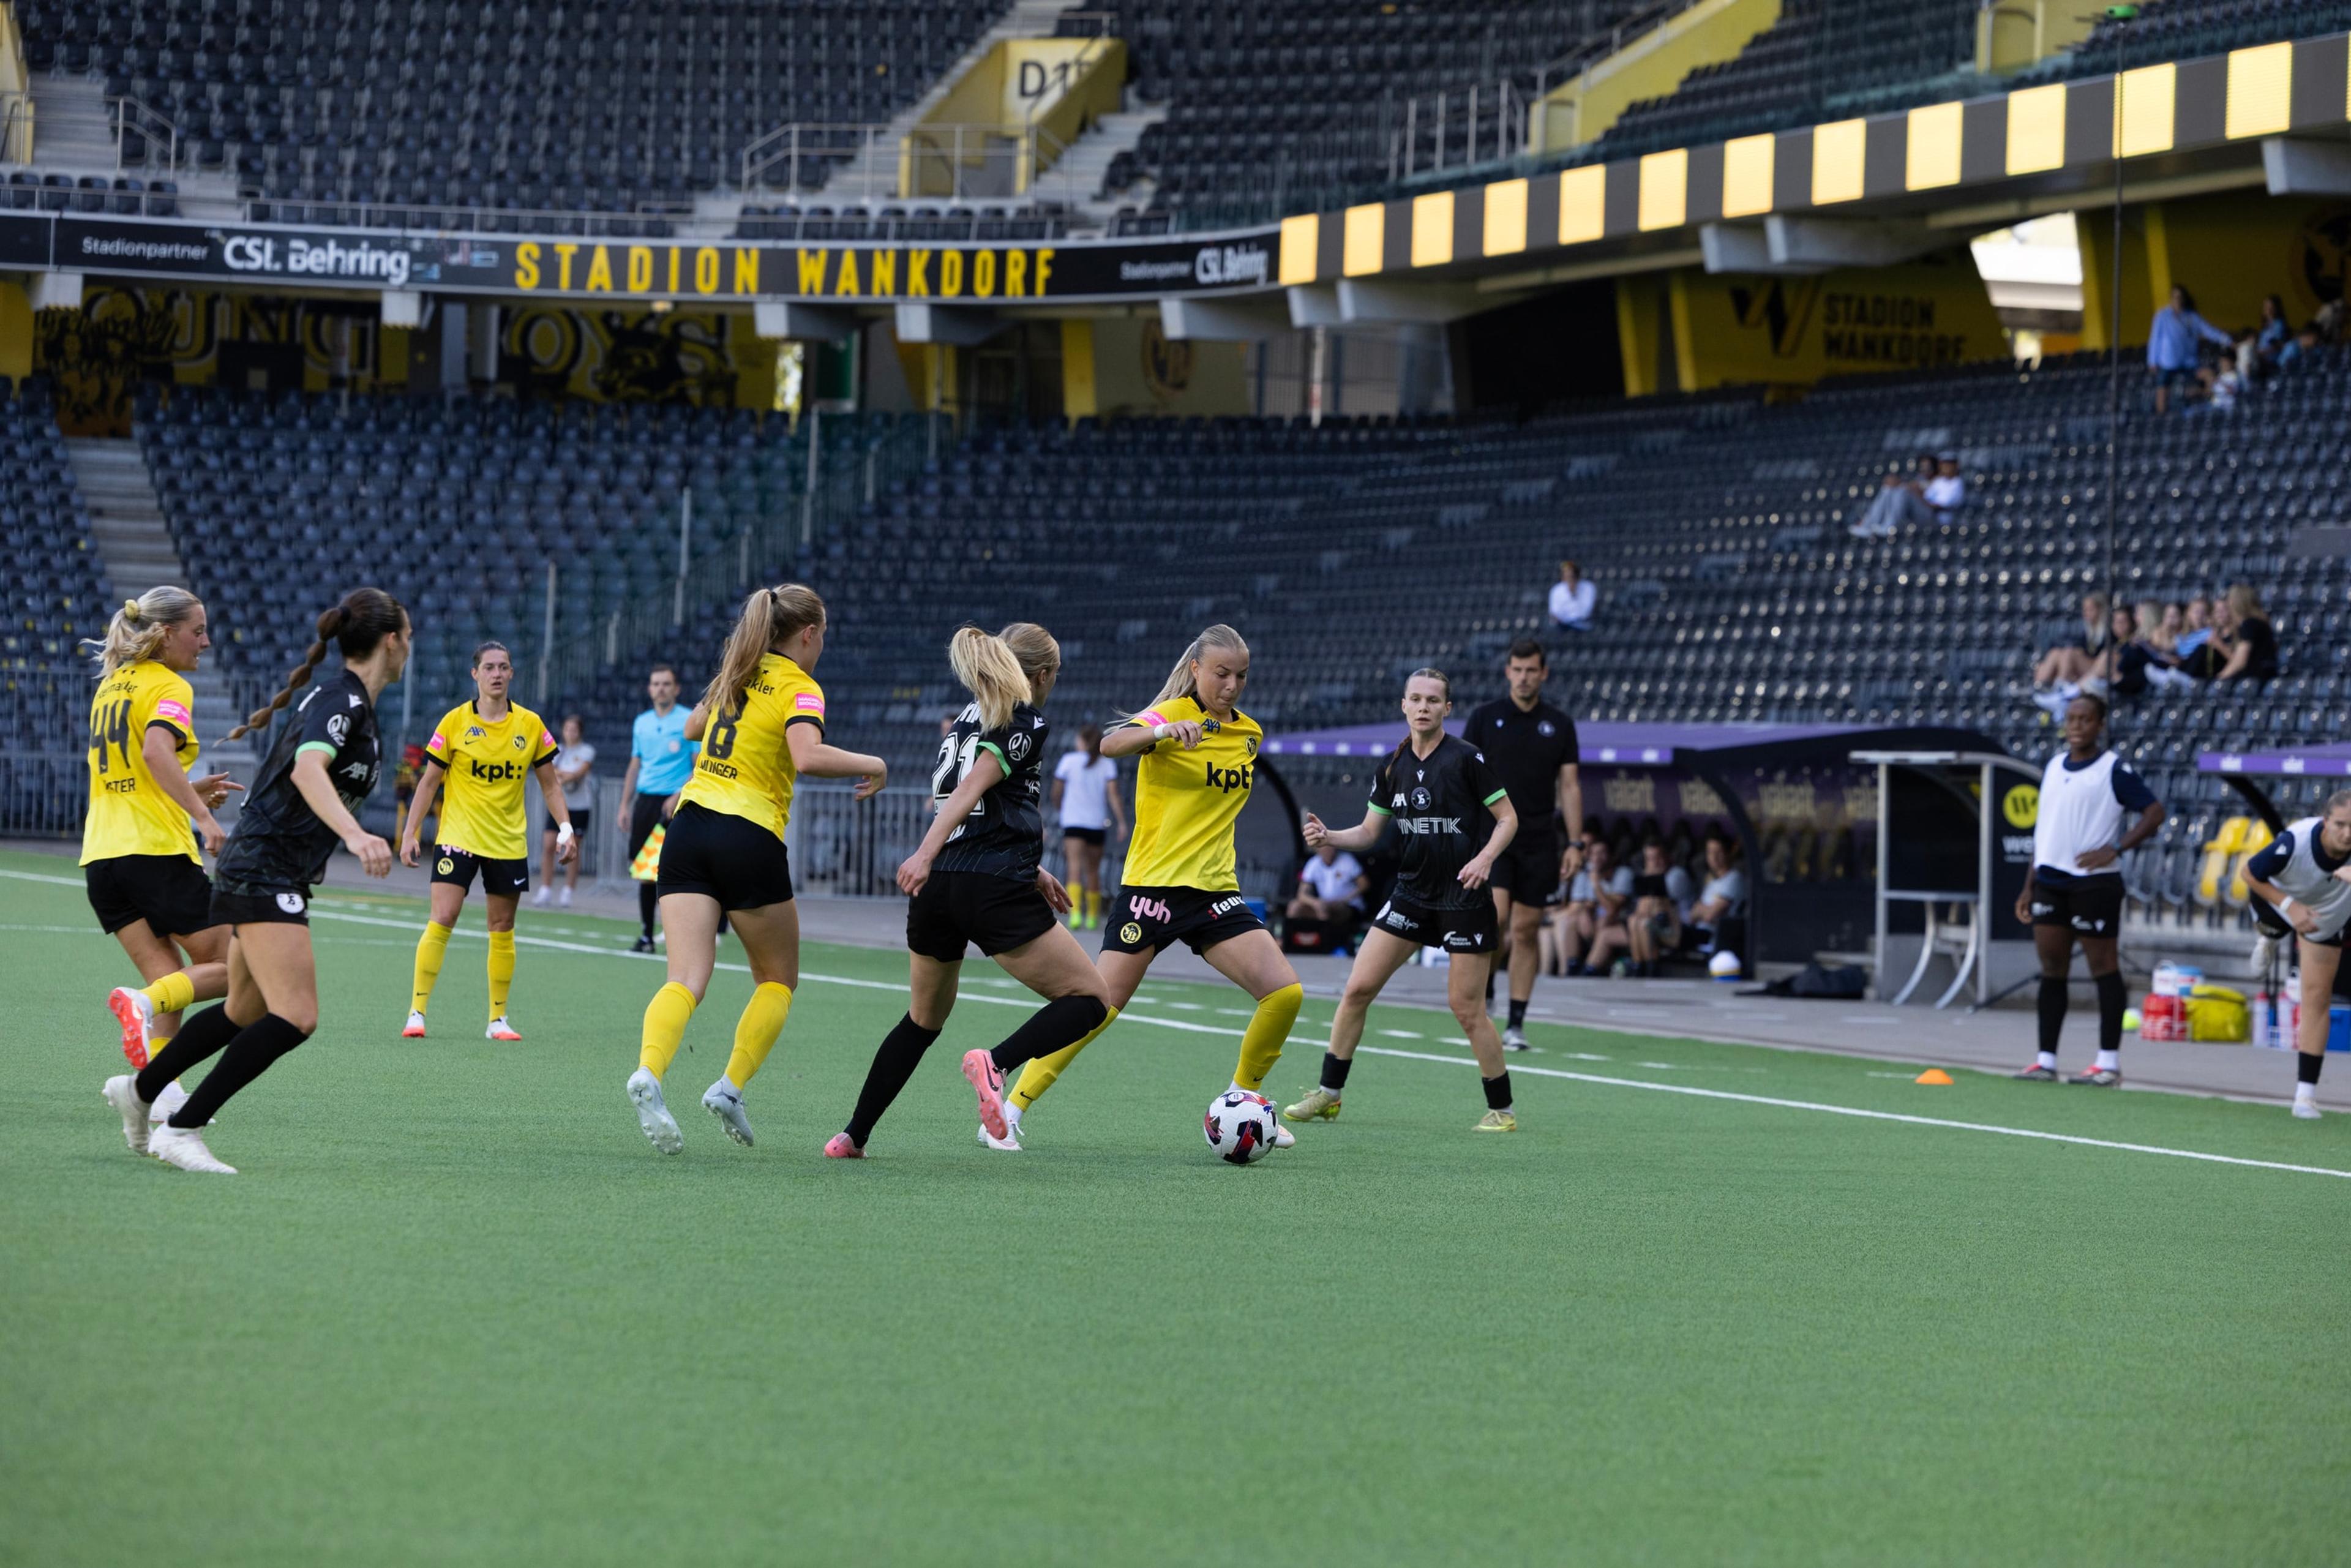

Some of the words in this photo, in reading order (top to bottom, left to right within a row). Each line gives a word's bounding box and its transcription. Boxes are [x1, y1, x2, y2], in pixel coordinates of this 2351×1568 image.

[82, 236, 209, 262] Stadionpartner
[288, 238, 410, 286] Behring
[515, 241, 760, 295] STADION
[797, 247, 1056, 298] WANKDORF
[1824, 293, 1935, 328] STADION
[90, 699, 132, 775] 44
[465, 726, 487, 737] AXA
[707, 689, 749, 760] 8
[1201, 718, 1221, 734] AXA
[339, 761, 369, 782] AXA
[471, 759, 523, 783] kpt:
[931, 732, 985, 816] 21
[1129, 895, 1172, 925] yuh
